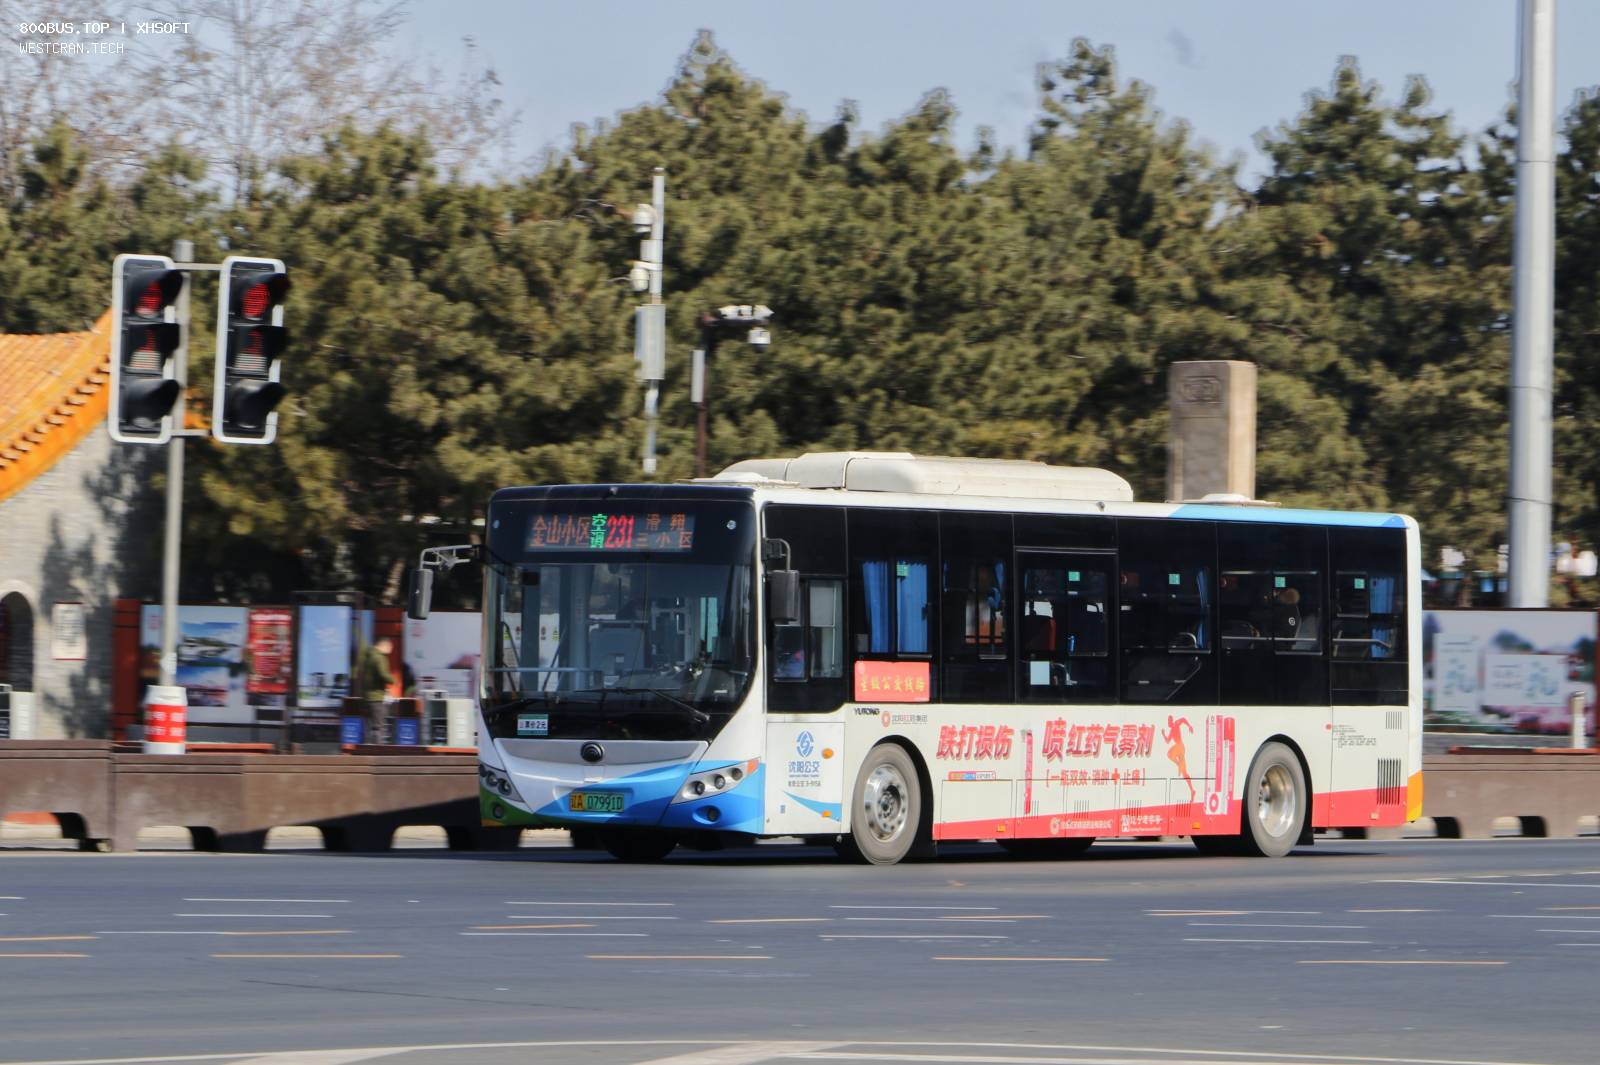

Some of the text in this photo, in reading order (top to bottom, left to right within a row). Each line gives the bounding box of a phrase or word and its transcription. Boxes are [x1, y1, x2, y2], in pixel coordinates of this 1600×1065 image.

[604, 514, 635, 548] 231
[854, 707, 880, 716] YUTONG
[936, 724, 1015, 760] 跌打损伤
[1042, 717, 1156, 763] 喷红药气雾剂
